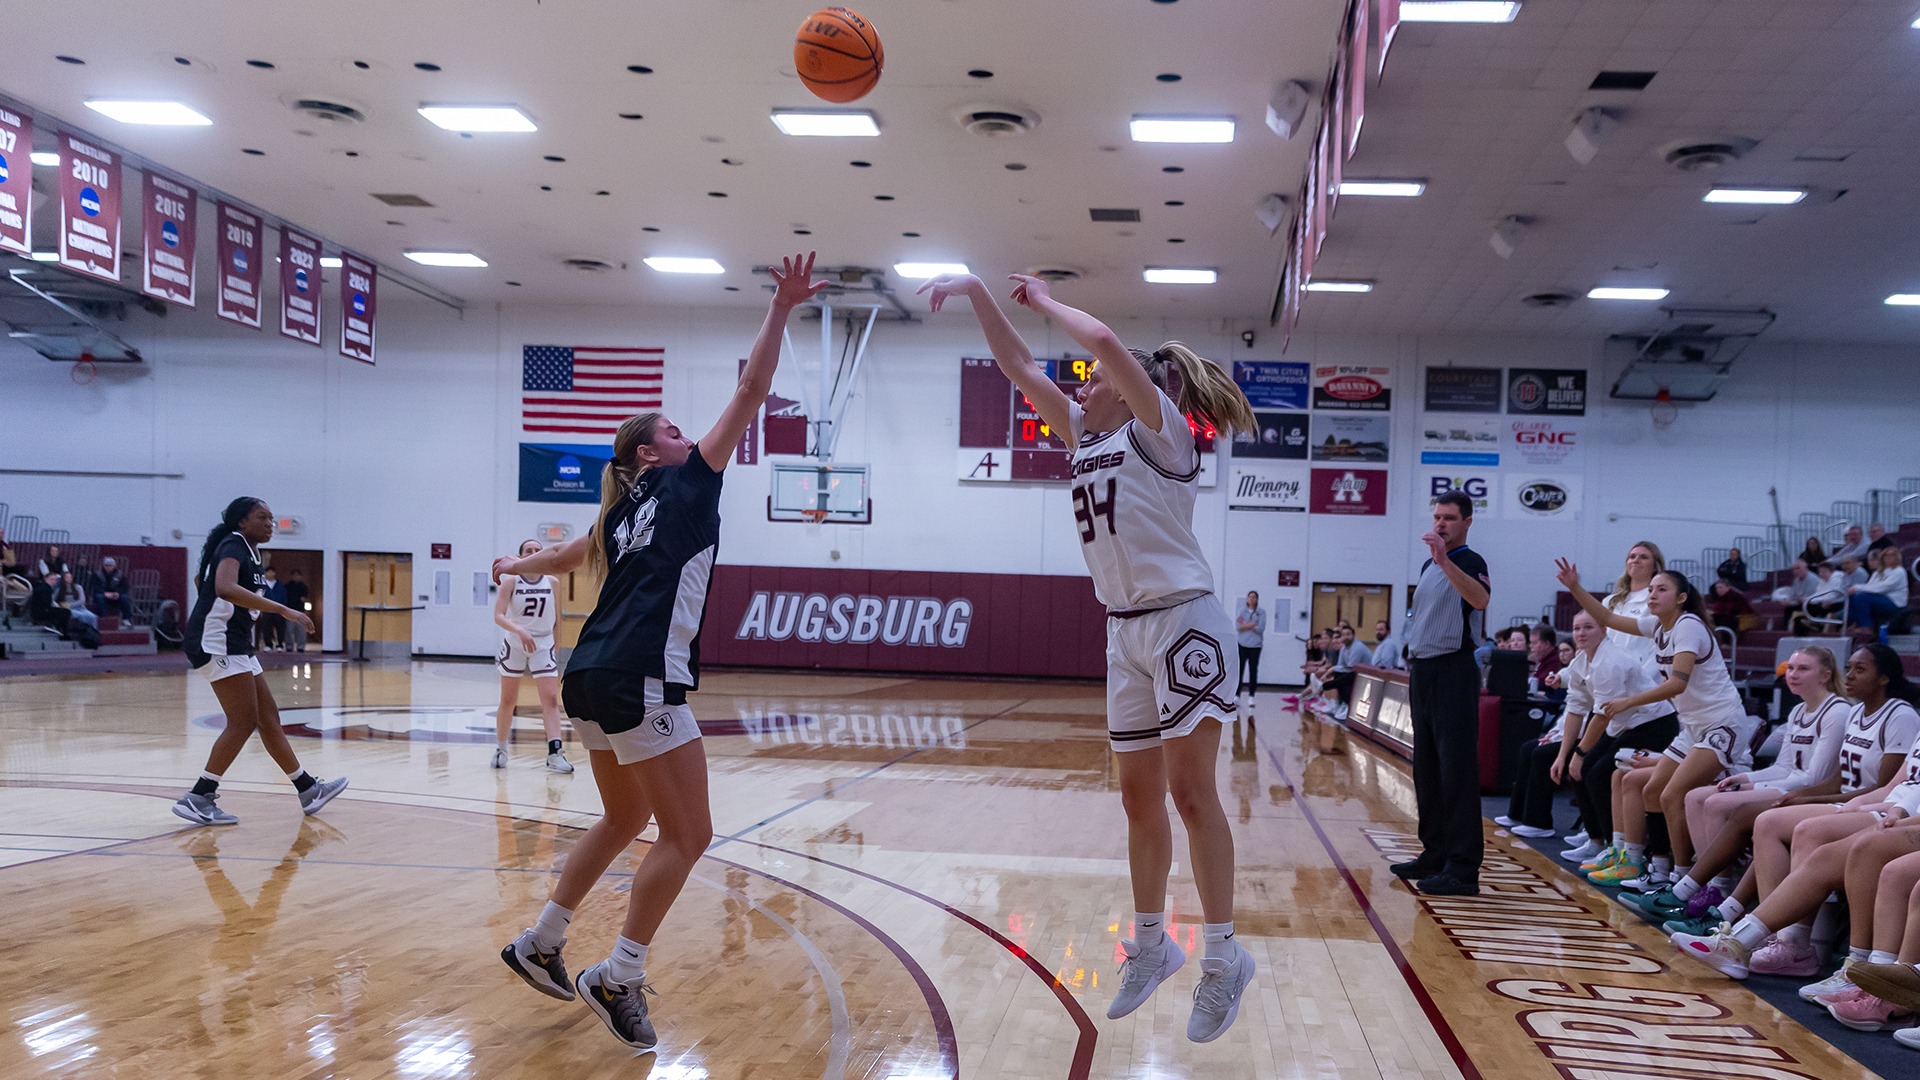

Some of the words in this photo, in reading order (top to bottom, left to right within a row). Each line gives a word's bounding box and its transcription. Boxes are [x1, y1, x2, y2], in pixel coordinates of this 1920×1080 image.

[69, 137, 112, 165] WRESTLING
[72, 157, 108, 190] 2010
[155, 193, 185, 221] 2015
[226, 223, 253, 248] 2019
[289, 247, 314, 270] 2023
[348, 271, 370, 294] 2024
[1256, 375, 1307, 384] ORTHOPEDICS
[1260, 367, 1279, 375] TWIN
[1281, 368, 1304, 376] CITIES
[1557, 376, 1575, 389] WE
[1516, 431, 1576, 445] GNC
[559, 466, 581, 474] NCAA
[553, 480, 576, 488] Division
[1236, 475, 1301, 497] Memory
[1072, 477, 1117, 545] 34
[522, 597, 547, 618] 21
[735, 591, 974, 648] AUGSBURG
[1841, 749, 1863, 788] 25
